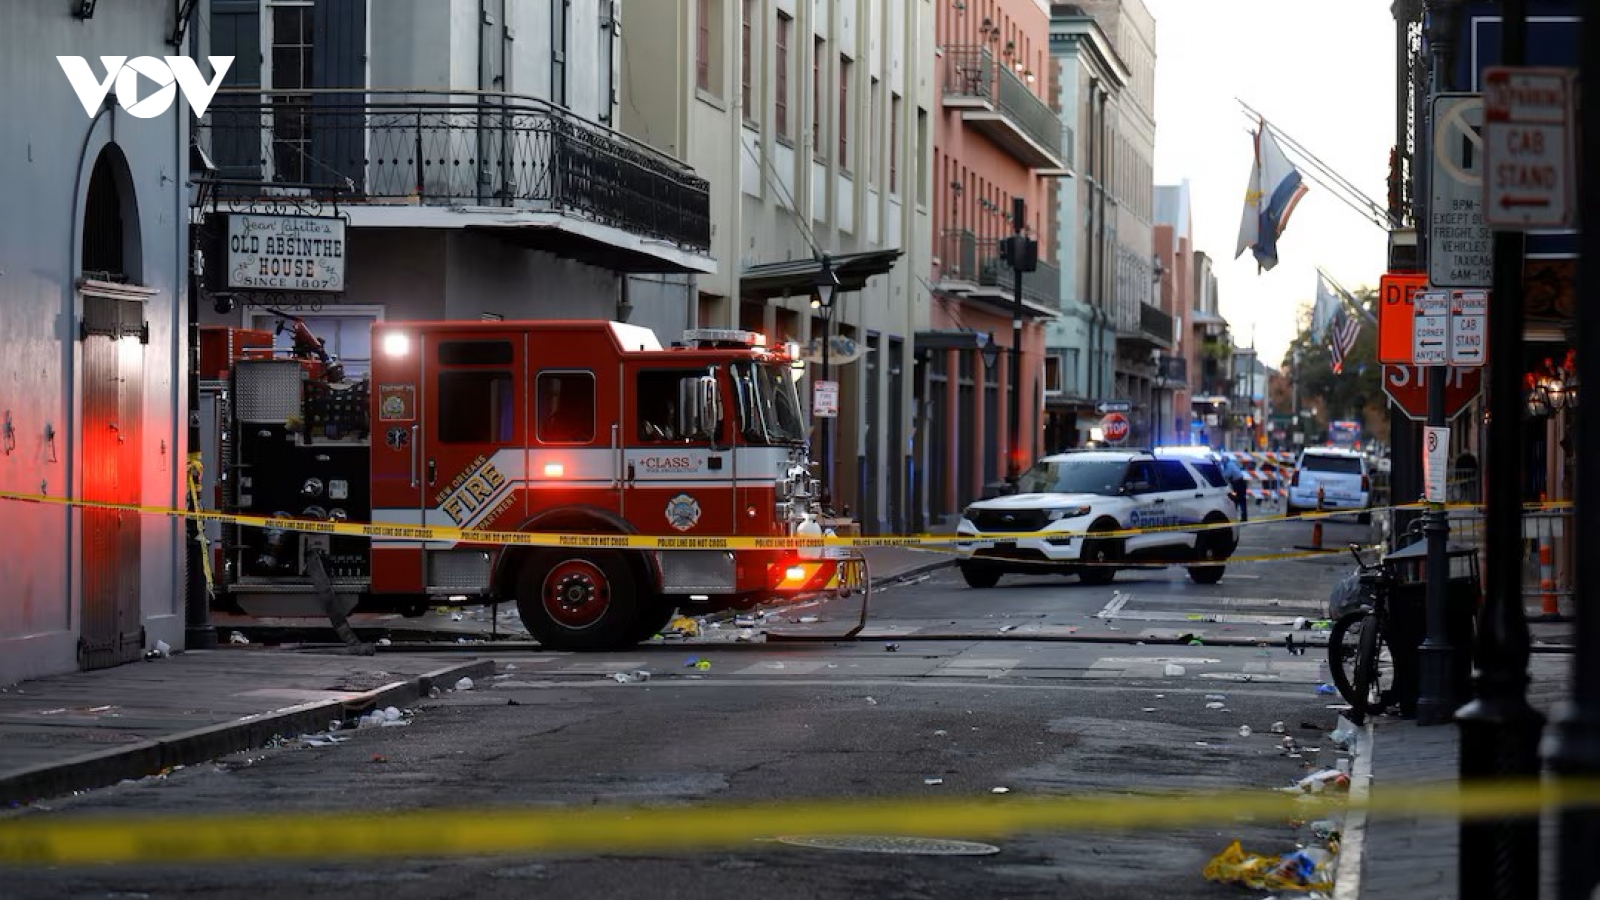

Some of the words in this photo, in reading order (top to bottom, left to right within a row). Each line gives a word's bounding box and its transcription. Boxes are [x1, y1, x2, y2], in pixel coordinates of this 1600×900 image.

[1507, 129, 1543, 154] CAB
[1496, 163, 1555, 188] STAND
[1434, 213, 1468, 224] EXCEPT
[231, 235, 259, 253] OLD
[266, 237, 341, 258] ABSINTHE
[1443, 241, 1487, 252] VEHICLES
[259, 258, 314, 277] HOUSE
[244, 277, 286, 287] SINCE
[295, 279, 329, 288] 1807
[1460, 319, 1476, 330] CAB
[1456, 336, 1480, 346] STAND
[645, 457, 690, 469] CLASS
[435, 486, 452, 503] NEW
[451, 455, 487, 487] ORLEANS
[443, 463, 506, 525] FIRE
[560, 536, 577, 545] POLICE
[611, 537, 629, 546] CROSS
[658, 539, 676, 547] POLICE
[709, 539, 727, 547] CROSS
[756, 539, 773, 548] POLICE
[806, 539, 824, 547] CROSS
